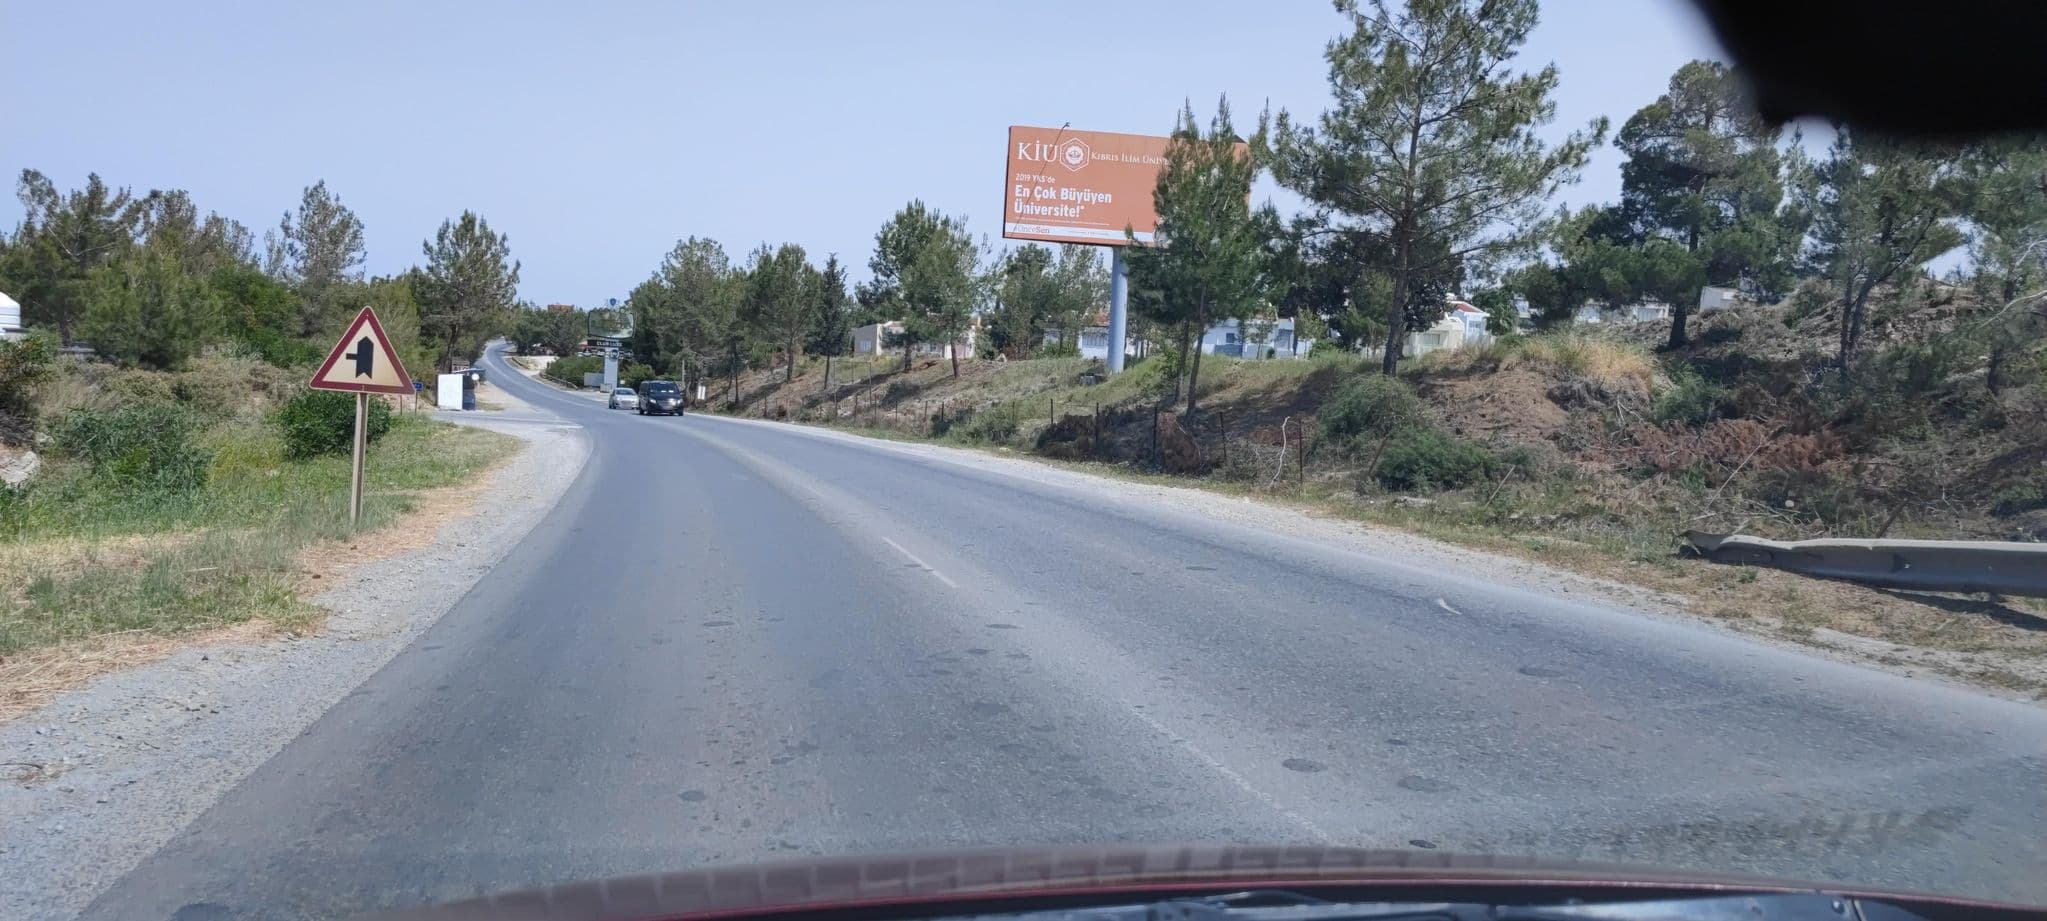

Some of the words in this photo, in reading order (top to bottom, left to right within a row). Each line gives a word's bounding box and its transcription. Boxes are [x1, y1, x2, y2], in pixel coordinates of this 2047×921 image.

[1018, 140, 1058, 162] KİÜ
[1016, 173, 1031, 182] 2019
[1015, 184, 1030, 198] En
[1034, 185, 1057, 201] Çok
[1060, 187, 1112, 205] Büyüyen
